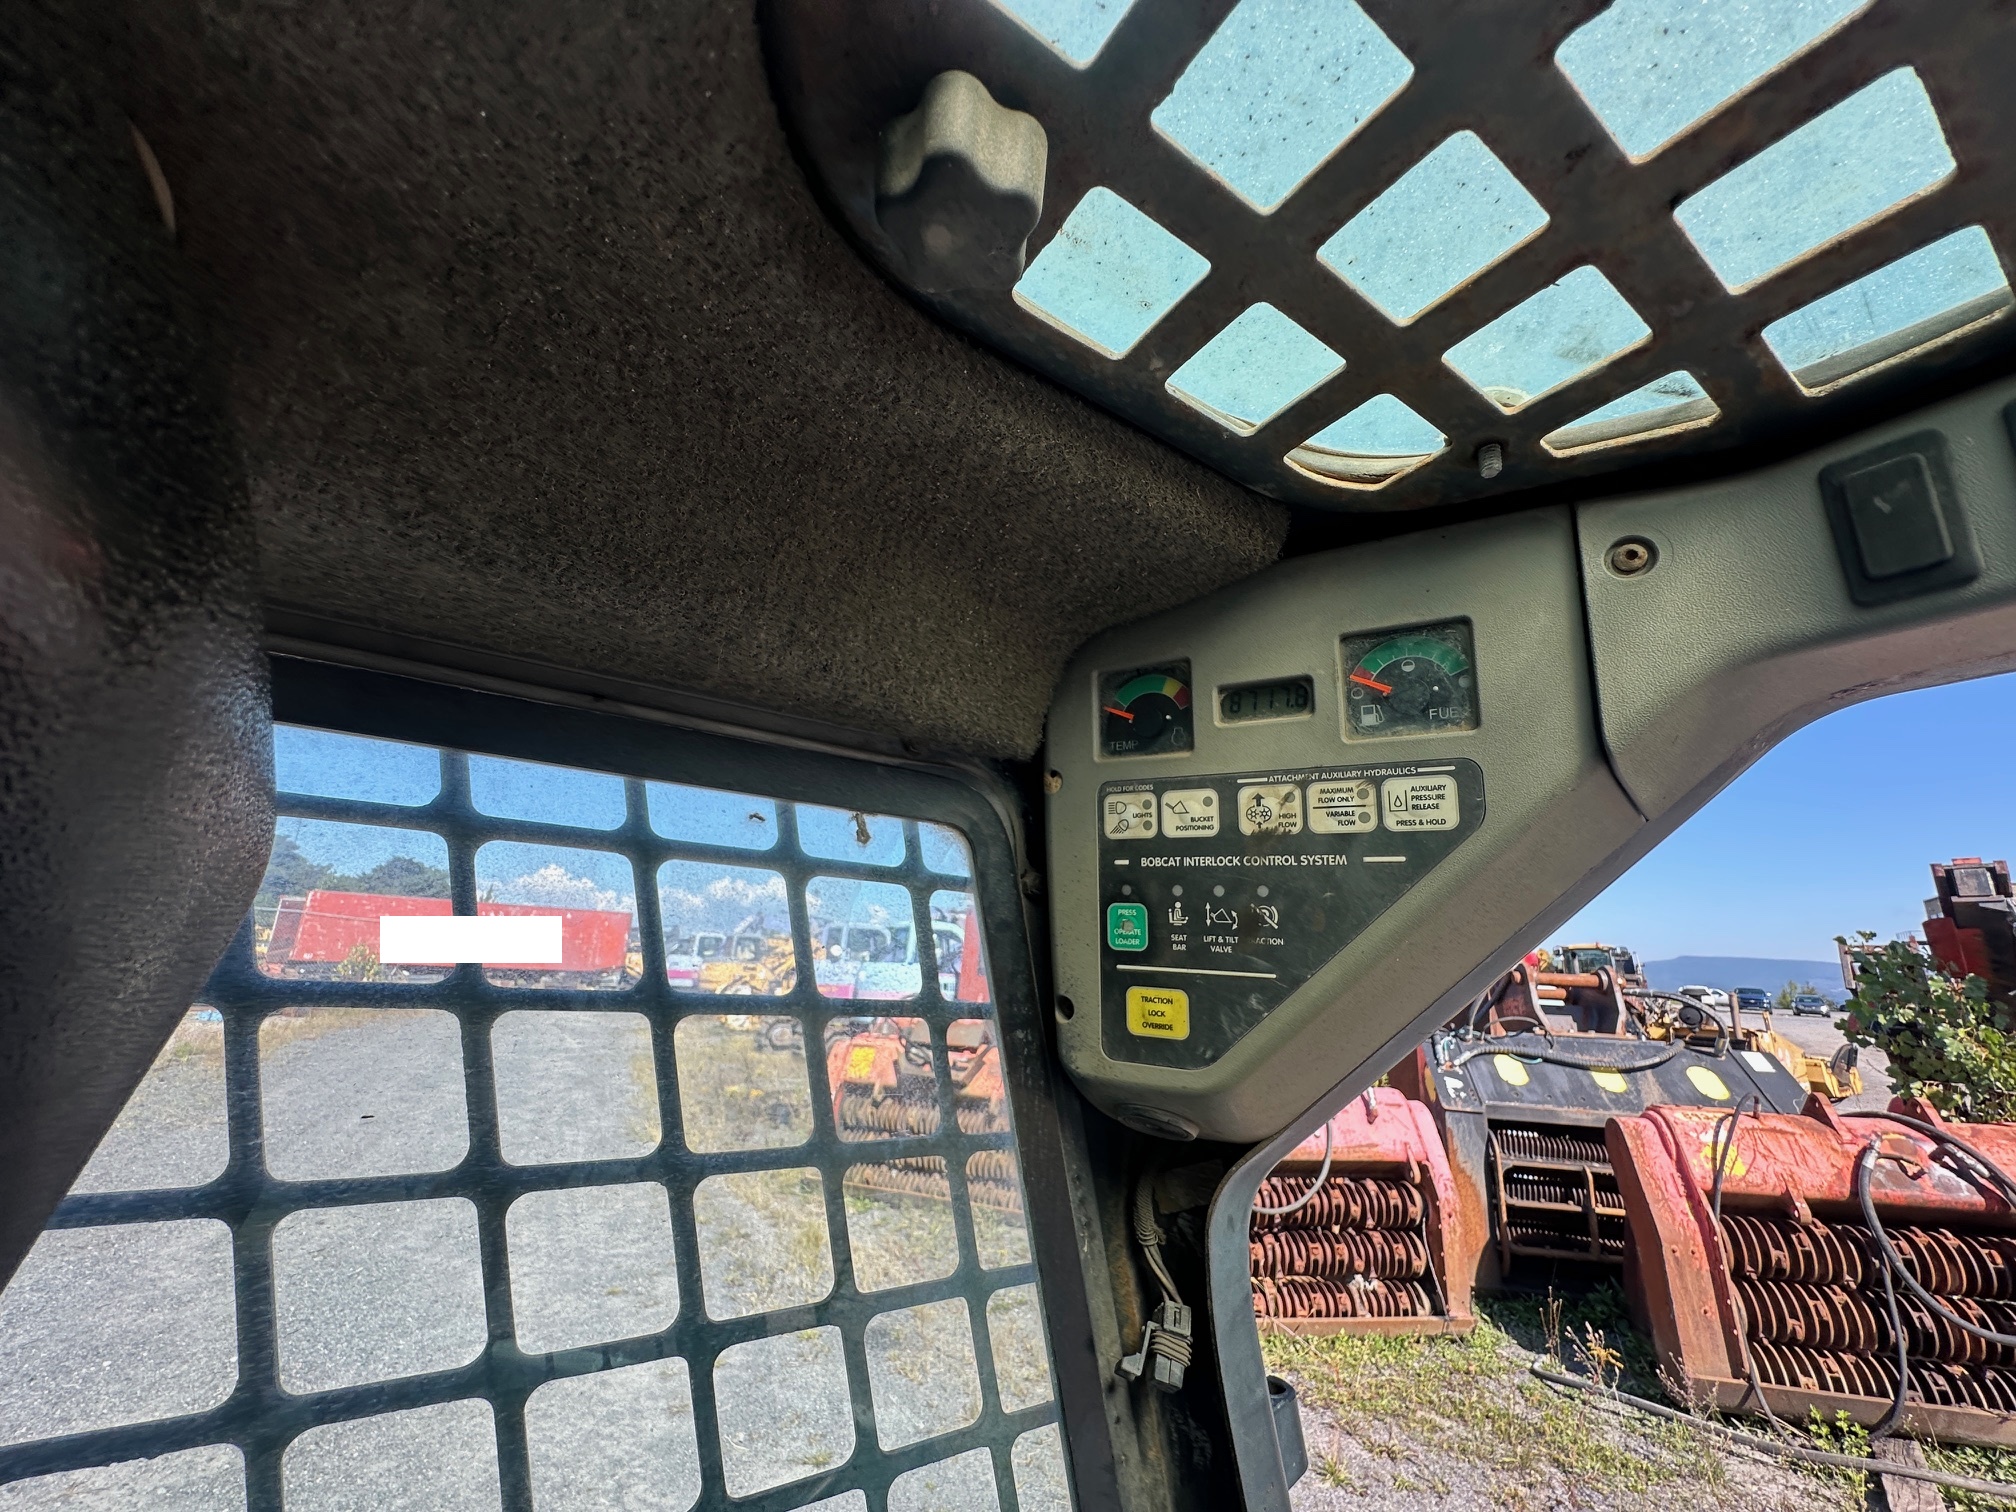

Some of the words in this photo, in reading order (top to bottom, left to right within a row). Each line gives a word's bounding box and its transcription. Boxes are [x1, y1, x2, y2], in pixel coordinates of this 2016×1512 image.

[1110, 740, 1139, 751] TEMP
[1268, 772, 1320, 783] ATTACHMENT
[1321, 770, 1362, 780] AUXILIARY
[1363, 766, 1416, 777] HYDRAULICS
[1319, 787, 1354, 795] MAXIMUM
[1410, 784, 1447, 792] AUXILIARY
[1410, 793, 1446, 801] PRESSURE
[1411, 802, 1440, 811] RELEASE
[1396, 819, 1417, 827] PRESS
[1425, 818, 1447, 826] HOLD
[1175, 824, 1215, 832] POSITIONING
[1140, 856, 1181, 867] BOBCAT
[1183, 856, 1241, 867] INTERLOCK
[1243, 855, 1298, 867] CONTROL
[1299, 854, 1348, 866] SYSTEM
[1117, 908, 1137, 916] PRESS
[1170, 934, 1188, 942] SEAT
[1203, 935, 1217, 943] LIFT
[1225, 936, 1239, 944] TILT
[1172, 943, 1187, 951] BAR
[1210, 945, 1233, 953] VALVE
[1141, 995, 1174, 1005] TRACTION
[1147, 1009, 1166, 1018] LOCK
[1141, 1021, 1174, 1031] OVERRIDE
